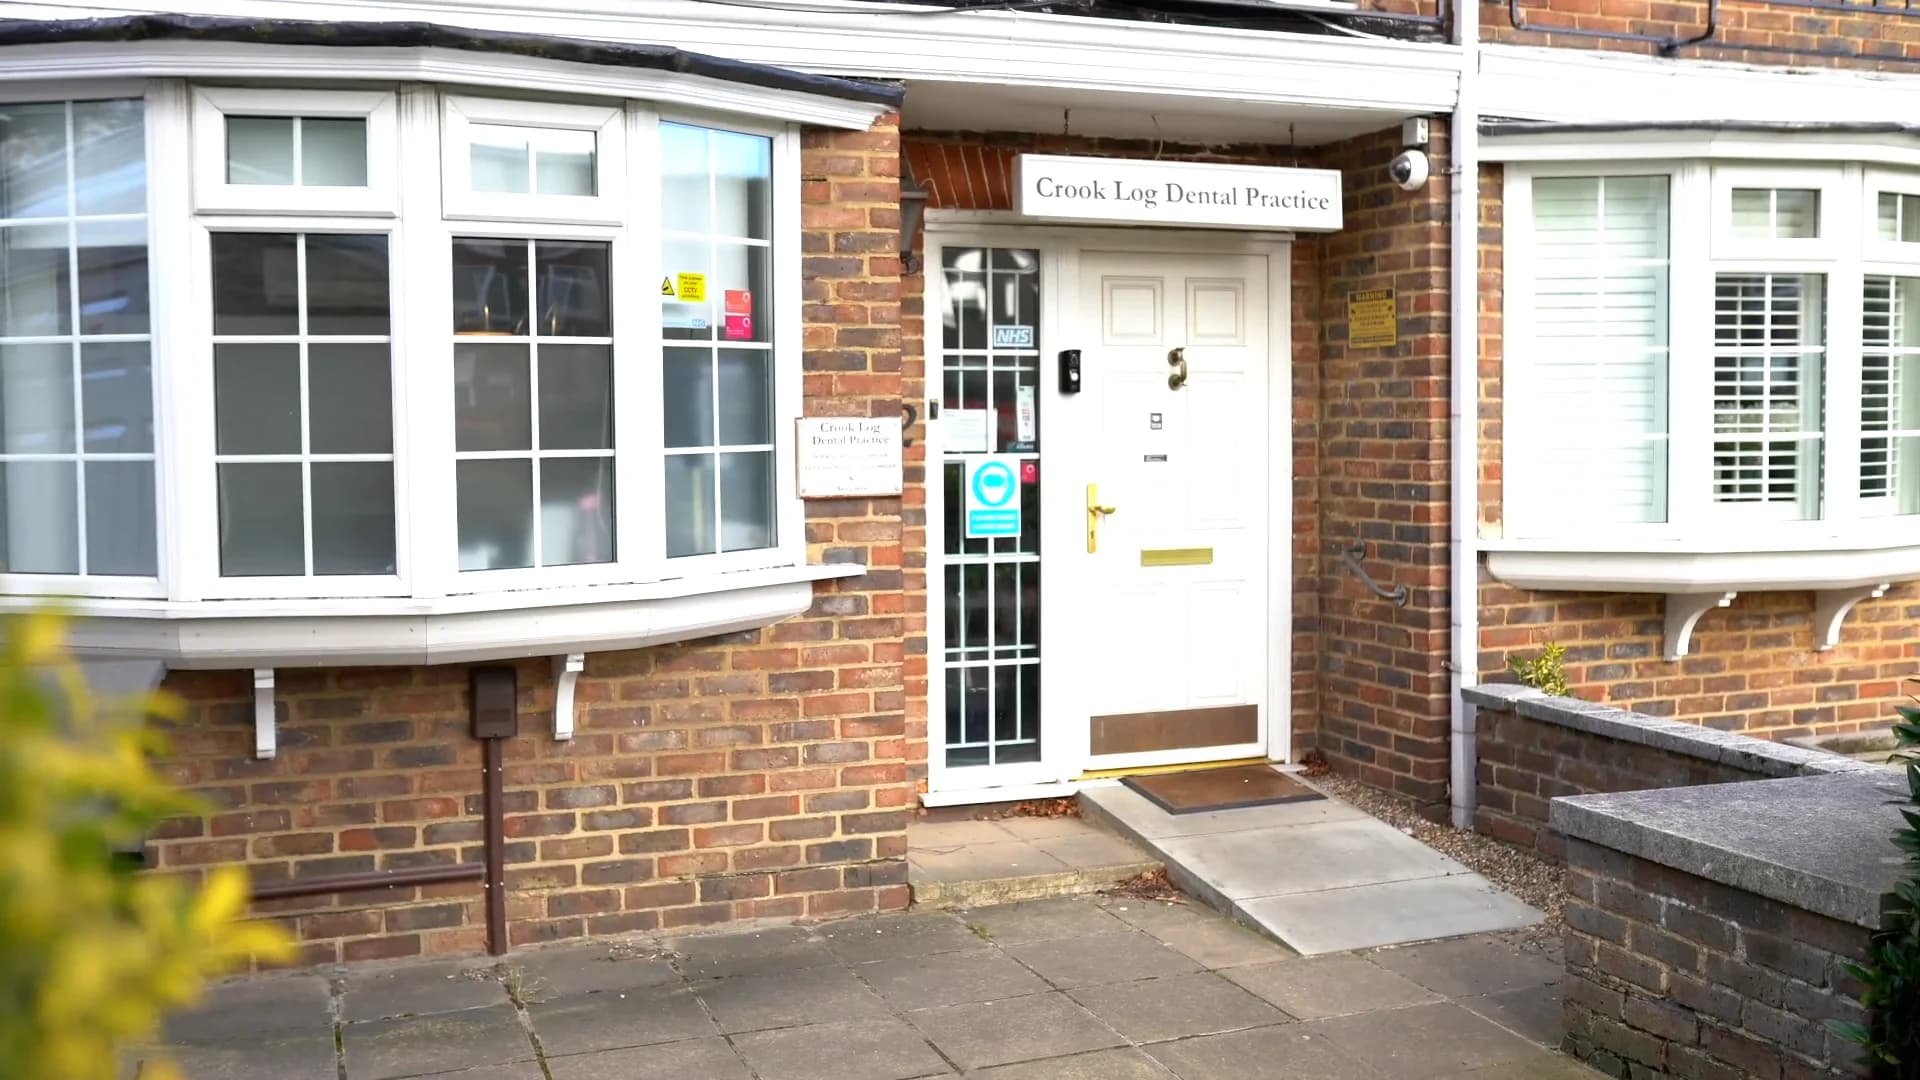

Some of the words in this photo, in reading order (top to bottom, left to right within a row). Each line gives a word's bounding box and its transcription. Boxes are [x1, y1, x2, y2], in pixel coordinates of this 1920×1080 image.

[1036, 176, 1106, 199] Crook
[1114, 180, 1158, 209] Log
[1165, 183, 1237, 206] Dental
[1246, 187, 1330, 210] Practice
[683, 286, 698, 294] CCTV
[1355, 290, 1386, 302] WARNING
[997, 329, 1029, 344] NHS
[820, 422, 855, 433] Crook
[859, 421, 881, 434] Log
[812, 435, 846, 446] Dental
[849, 435, 889, 445] Practice
